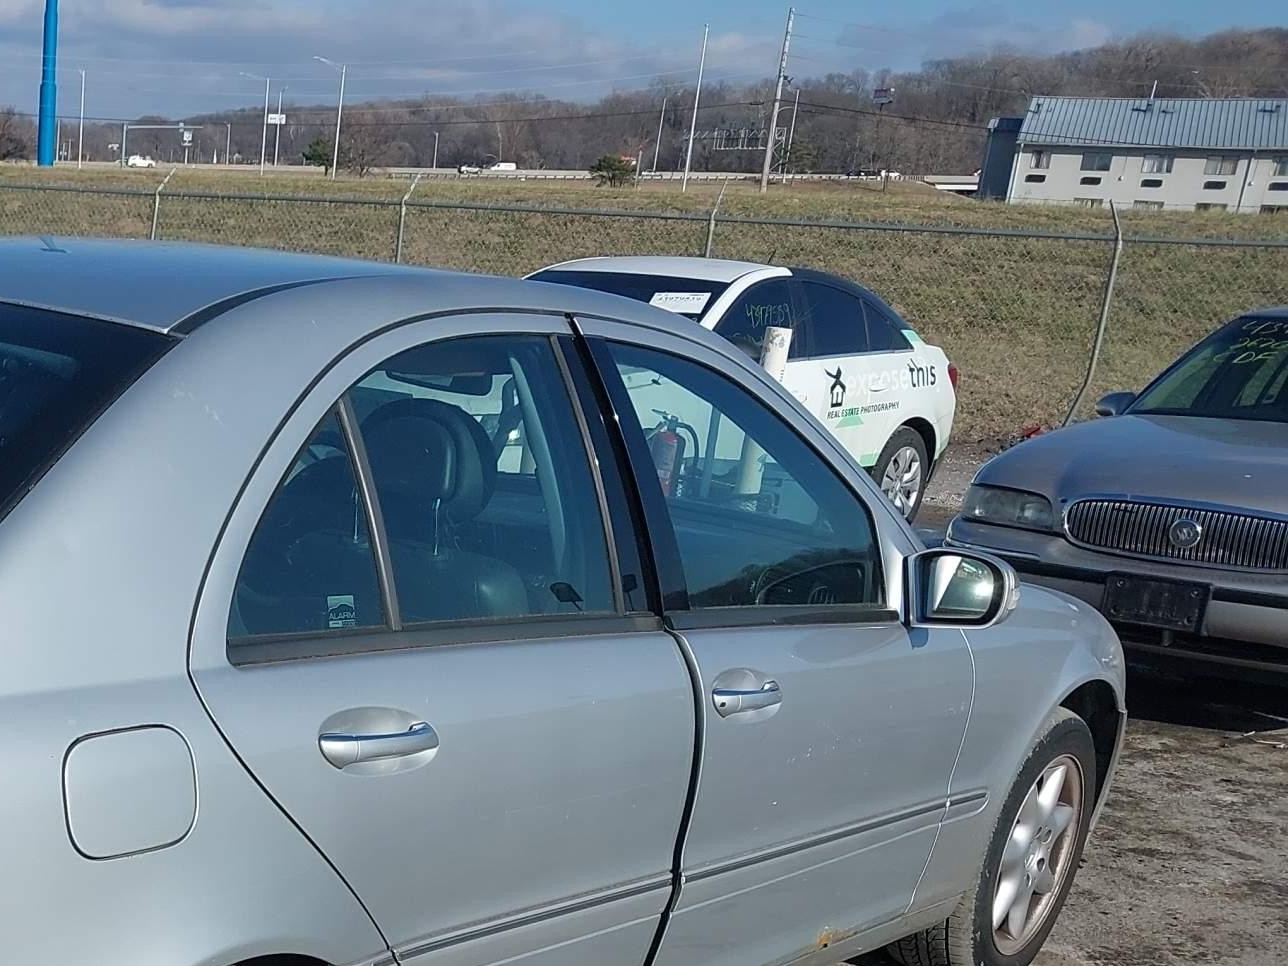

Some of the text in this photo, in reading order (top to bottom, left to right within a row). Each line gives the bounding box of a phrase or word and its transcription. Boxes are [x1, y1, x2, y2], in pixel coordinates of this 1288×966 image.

[907, 358, 937, 388] this
[826, 401, 900, 419] REAL ESTATE PHOTOGRAPHY
[328, 611, 356, 620] ALARM
